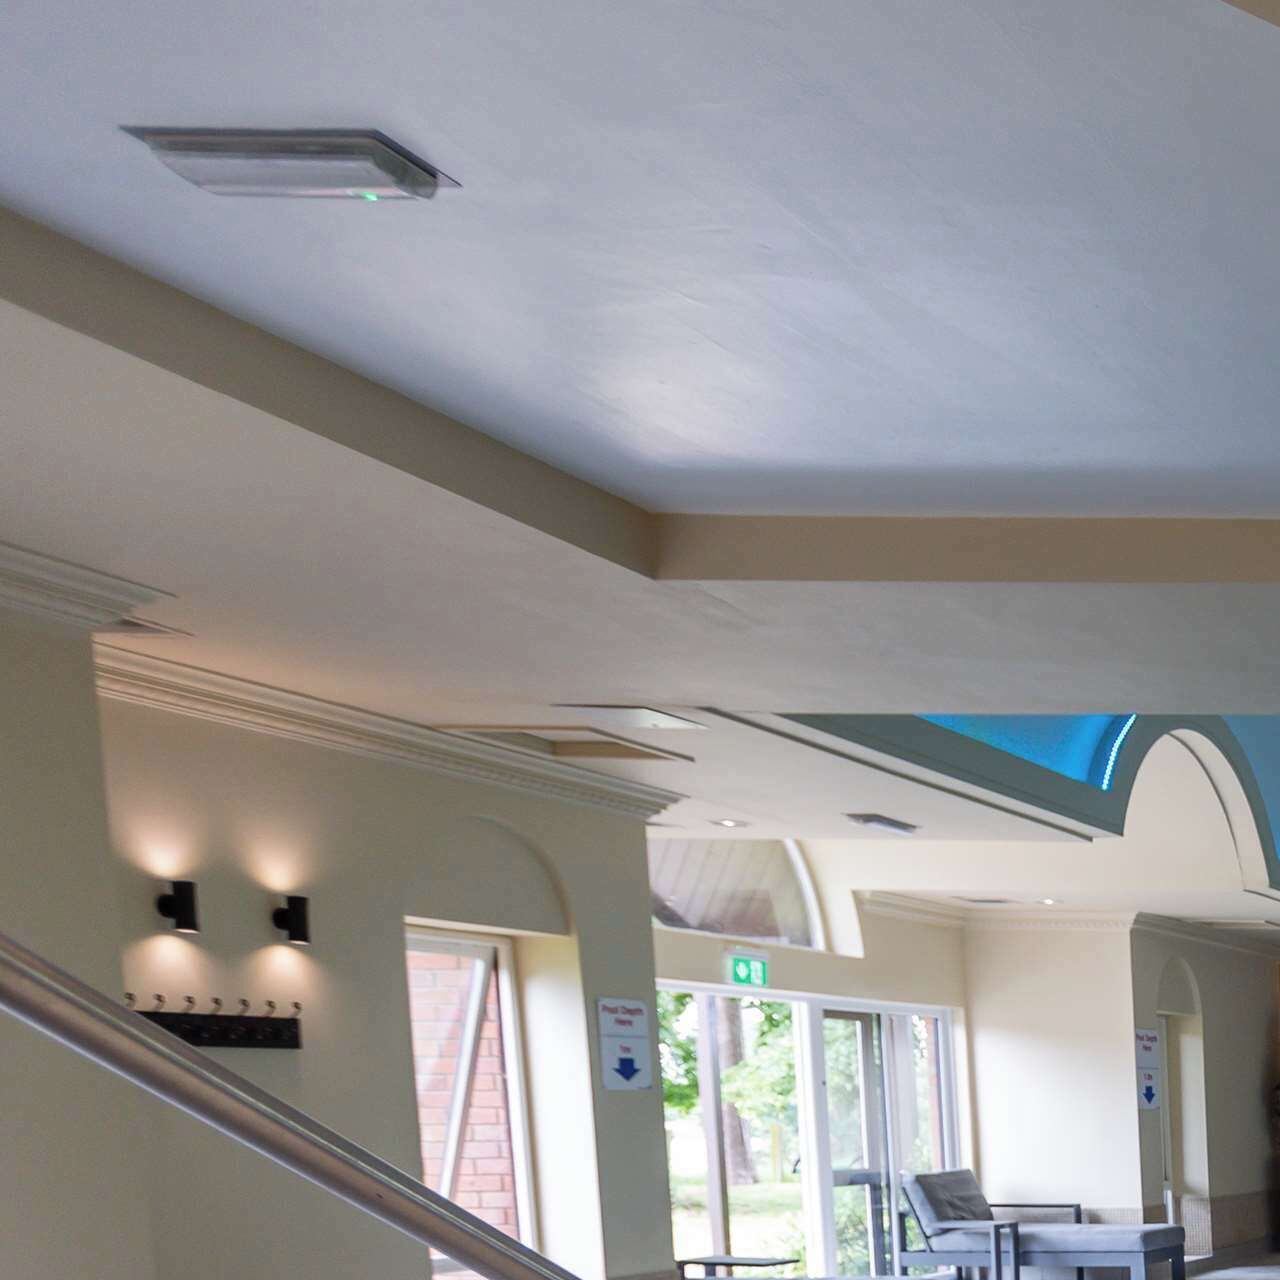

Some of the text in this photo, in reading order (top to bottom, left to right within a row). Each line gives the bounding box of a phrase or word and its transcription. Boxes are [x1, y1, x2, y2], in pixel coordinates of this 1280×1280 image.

[601, 1004, 644, 1015] Pool Depth
[614, 1017, 632, 1026] Here
